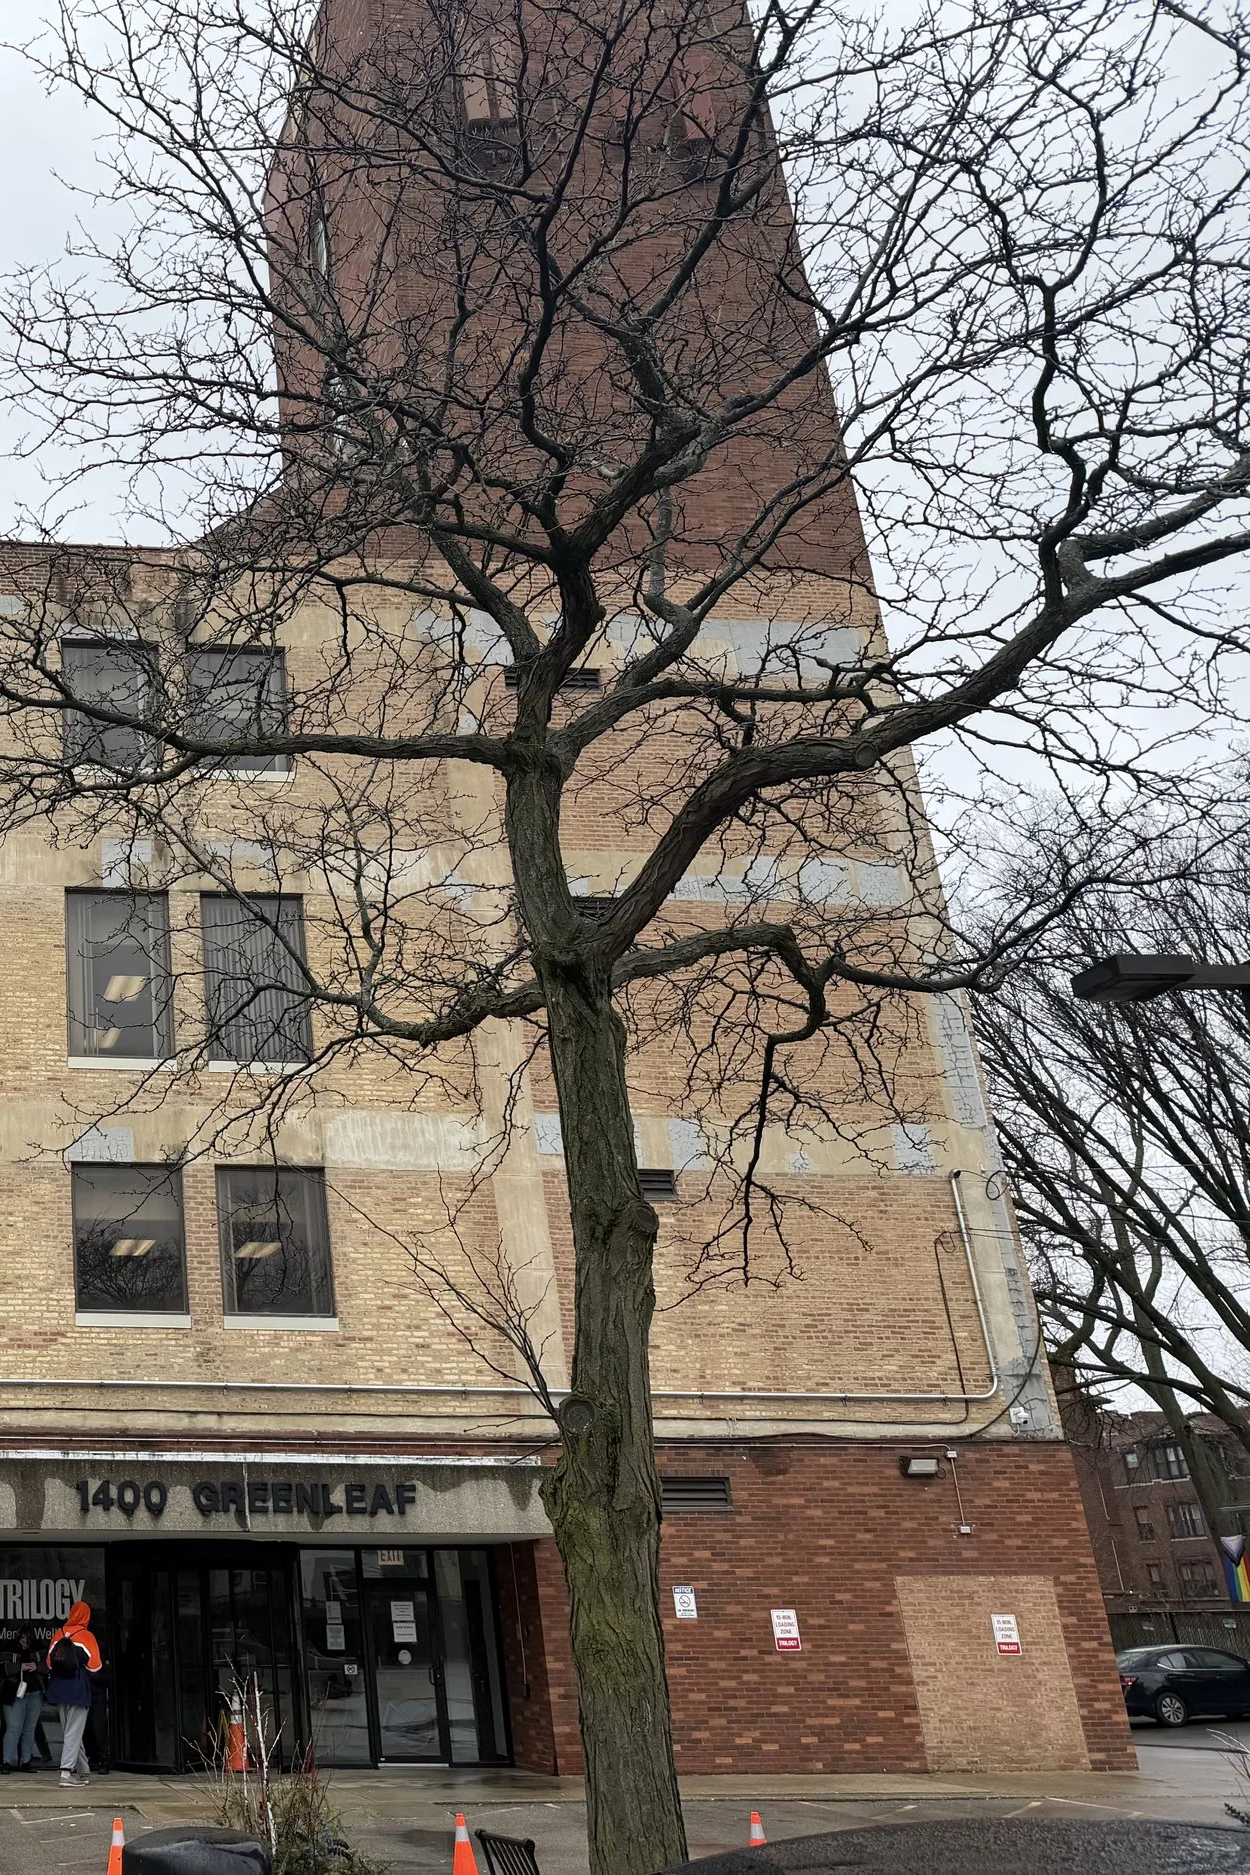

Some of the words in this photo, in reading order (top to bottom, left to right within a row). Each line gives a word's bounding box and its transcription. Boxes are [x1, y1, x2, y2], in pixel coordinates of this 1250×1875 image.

[76, 1480, 168, 1514] 1400
[193, 1481, 416, 1515] GREENLEAF
[381, 1550, 400, 1562] EXIT
